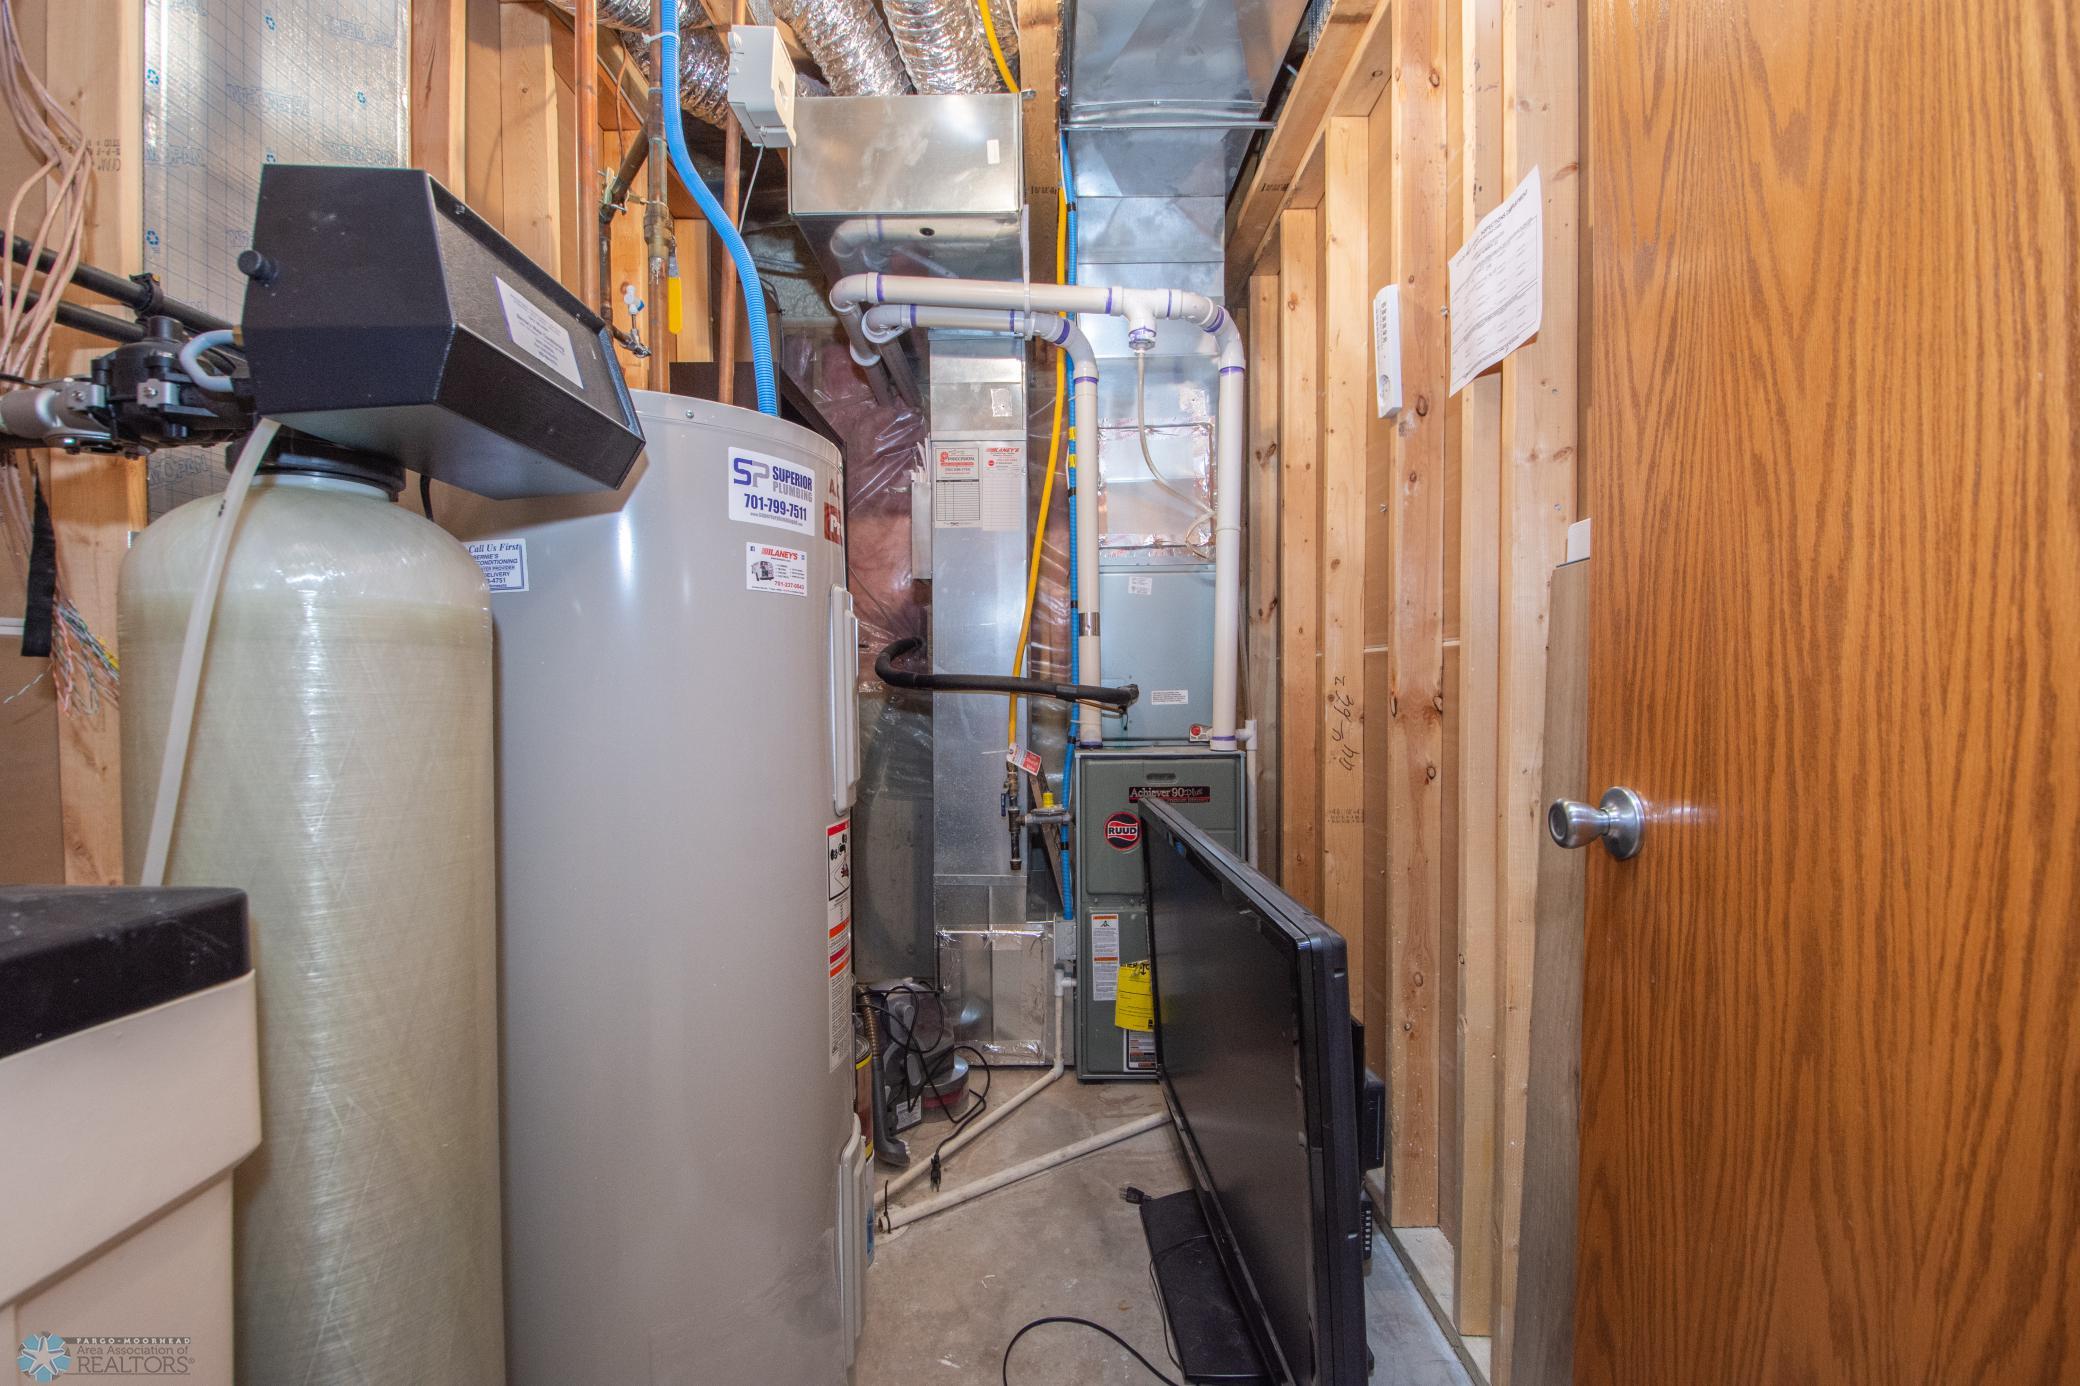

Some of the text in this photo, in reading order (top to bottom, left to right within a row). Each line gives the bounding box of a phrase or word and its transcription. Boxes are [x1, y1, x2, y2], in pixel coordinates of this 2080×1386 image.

[772, 465, 813, 492] SUPERIOR
[772, 480, 813, 503] PLUMBING
[743, 493, 807, 521] 701-799-7511
[468, 542, 519, 553] Call Us First
[1130, 787, 1171, 799] Achiever
[1108, 826, 1137, 836] RUUD
